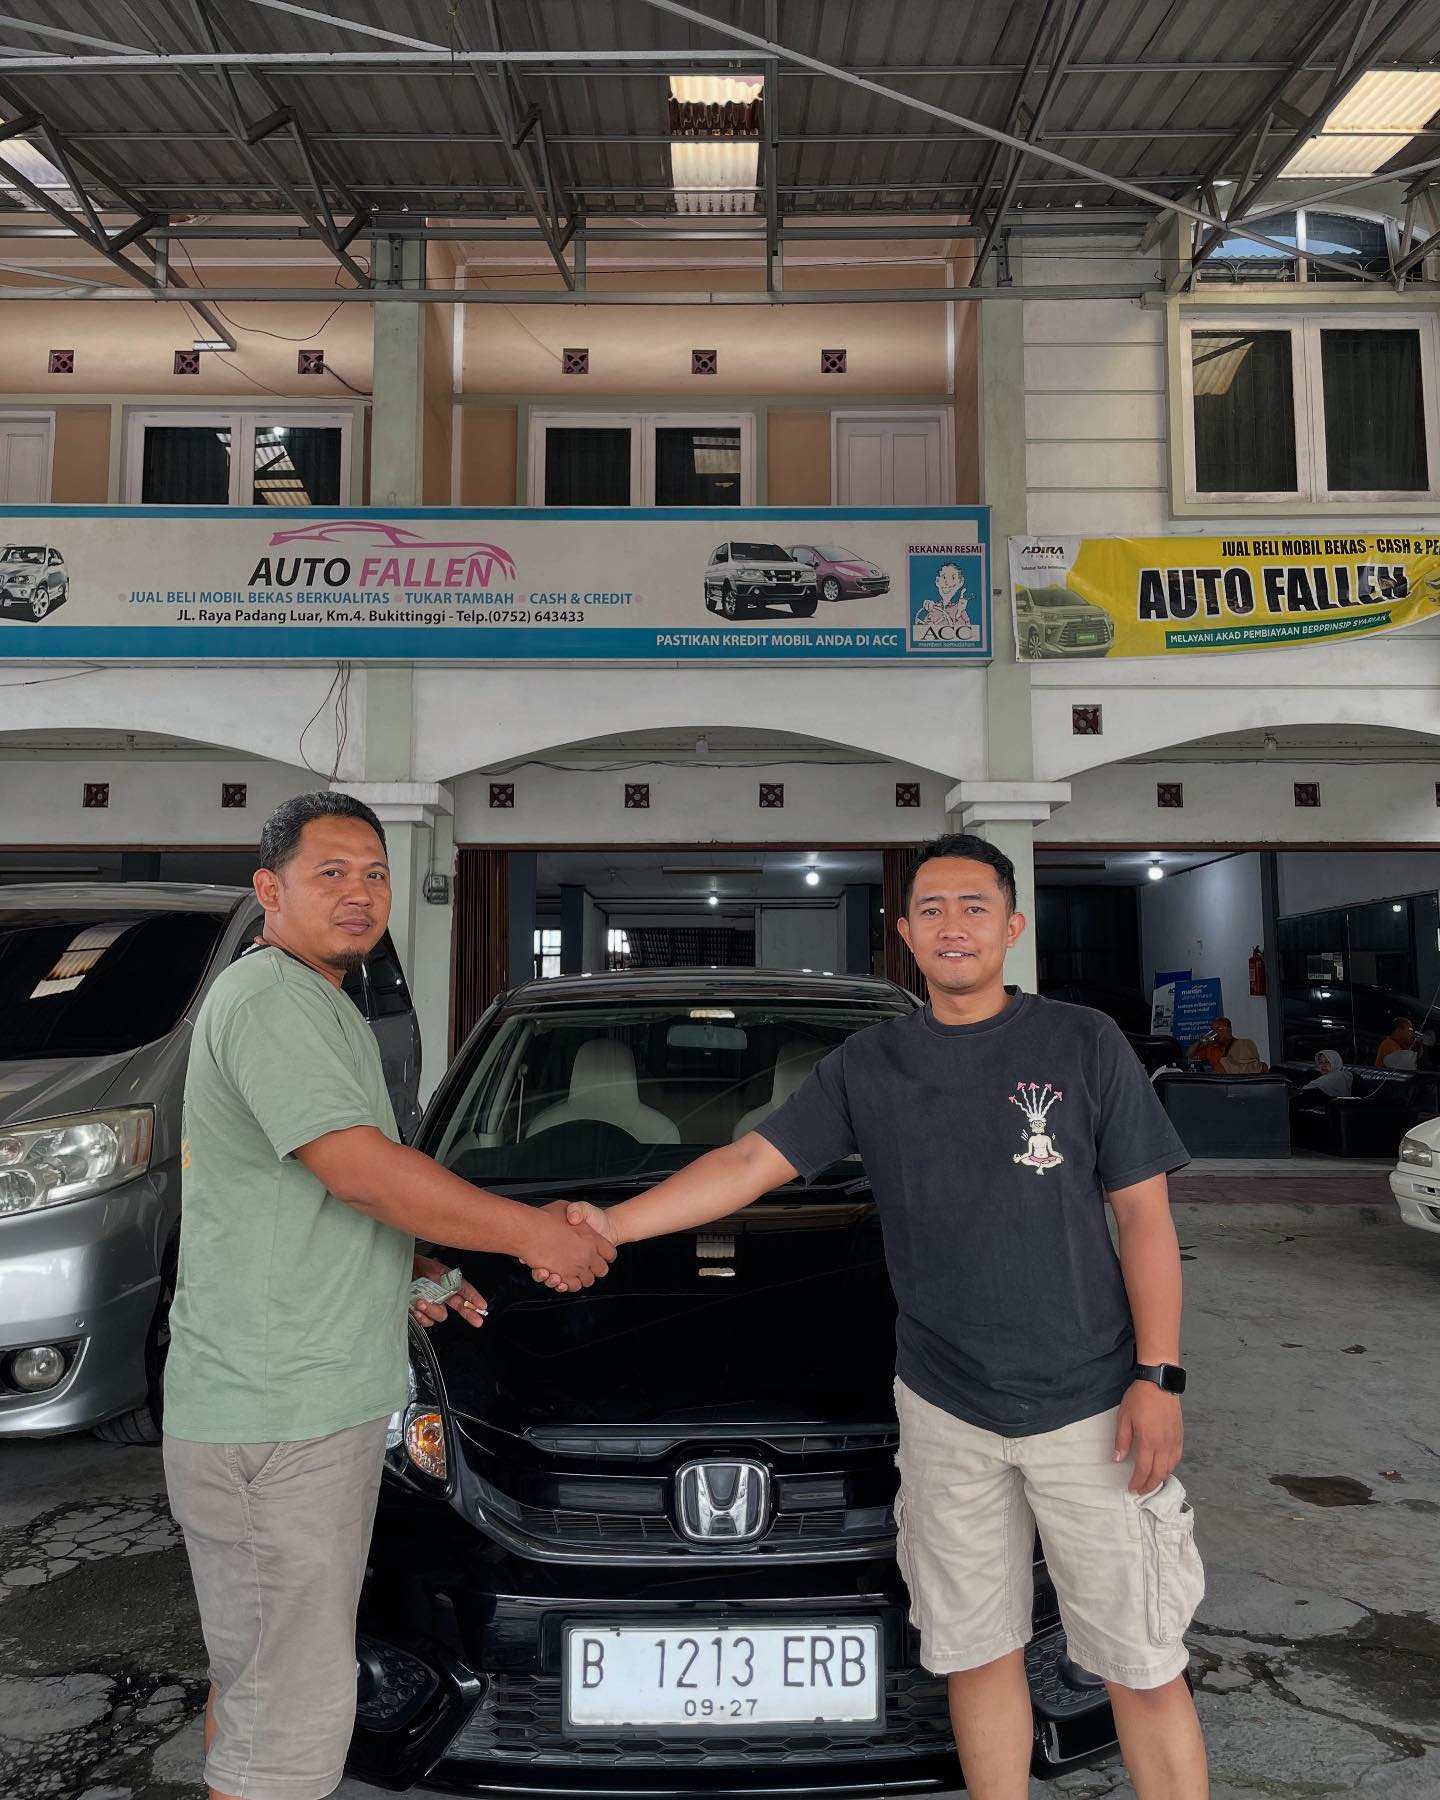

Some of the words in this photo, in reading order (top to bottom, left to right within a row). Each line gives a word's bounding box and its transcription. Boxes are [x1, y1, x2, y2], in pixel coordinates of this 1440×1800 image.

[909, 545, 953, 553] REKANAN
[954, 545, 982, 553] RESMI
[1021, 546, 1064, 554] ADIRA
[1222, 541, 1250, 556] JUAL
[1253, 540, 1279, 556] BELI
[1282, 540, 1322, 556] MOBIL
[1324, 539, 1367, 555] BEKAS
[1376, 538, 1411, 554] CASH
[1414, 541, 1423, 554] &
[1425, 539, 1440, 555] PE
[248, 557, 351, 587] AUTO
[359, 557, 493, 587] FALLEN
[129, 591, 163, 603] JUAL
[167, 591, 196, 603] BELI
[200, 591, 244, 603] MOBIL
[248, 592, 292, 604] BEKAS
[297, 592, 389, 604] BERKUALITAS
[405, 592, 452, 604] TUKAR
[455, 592, 514, 604] TAMBAH
[529, 593, 567, 604] CASH
[571, 593, 580, 604] &
[584, 593, 632, 604] CREDIT
[1139, 567, 1255, 619] AUTO
[1264, 566, 1409, 612] FALLEN
[177, 609, 195, 621] JL.
[199, 609, 231, 624] Raya
[235, 609, 286, 624] Padang
[290, 610, 323, 623] Luar,
[327, 610, 365, 621] Km.4.
[369, 610, 446, 625] Bukittinggi
[535, 611, 584, 622] 643433
[656, 634, 720, 646] PASTIKAN
[722, 634, 768, 646] KREDIT
[771, 634, 813, 646] MOBIL
[816, 634, 853, 646] ANDA
[856, 634, 870, 646] DI
[872, 634, 898, 646] ACC
[921, 625, 973, 641] ACC
[1170, 633, 1213, 643] MELAYANI
[1216, 631, 1241, 641] AKAD
[1243, 627, 1300, 639] PEMBIAYAAN
[1302, 621, 1351, 634] BERPRINSIP
[582, 1638, 604, 1688] B
[654, 1637, 754, 1688] 1213
[783, 1636, 866, 1687] ERB
